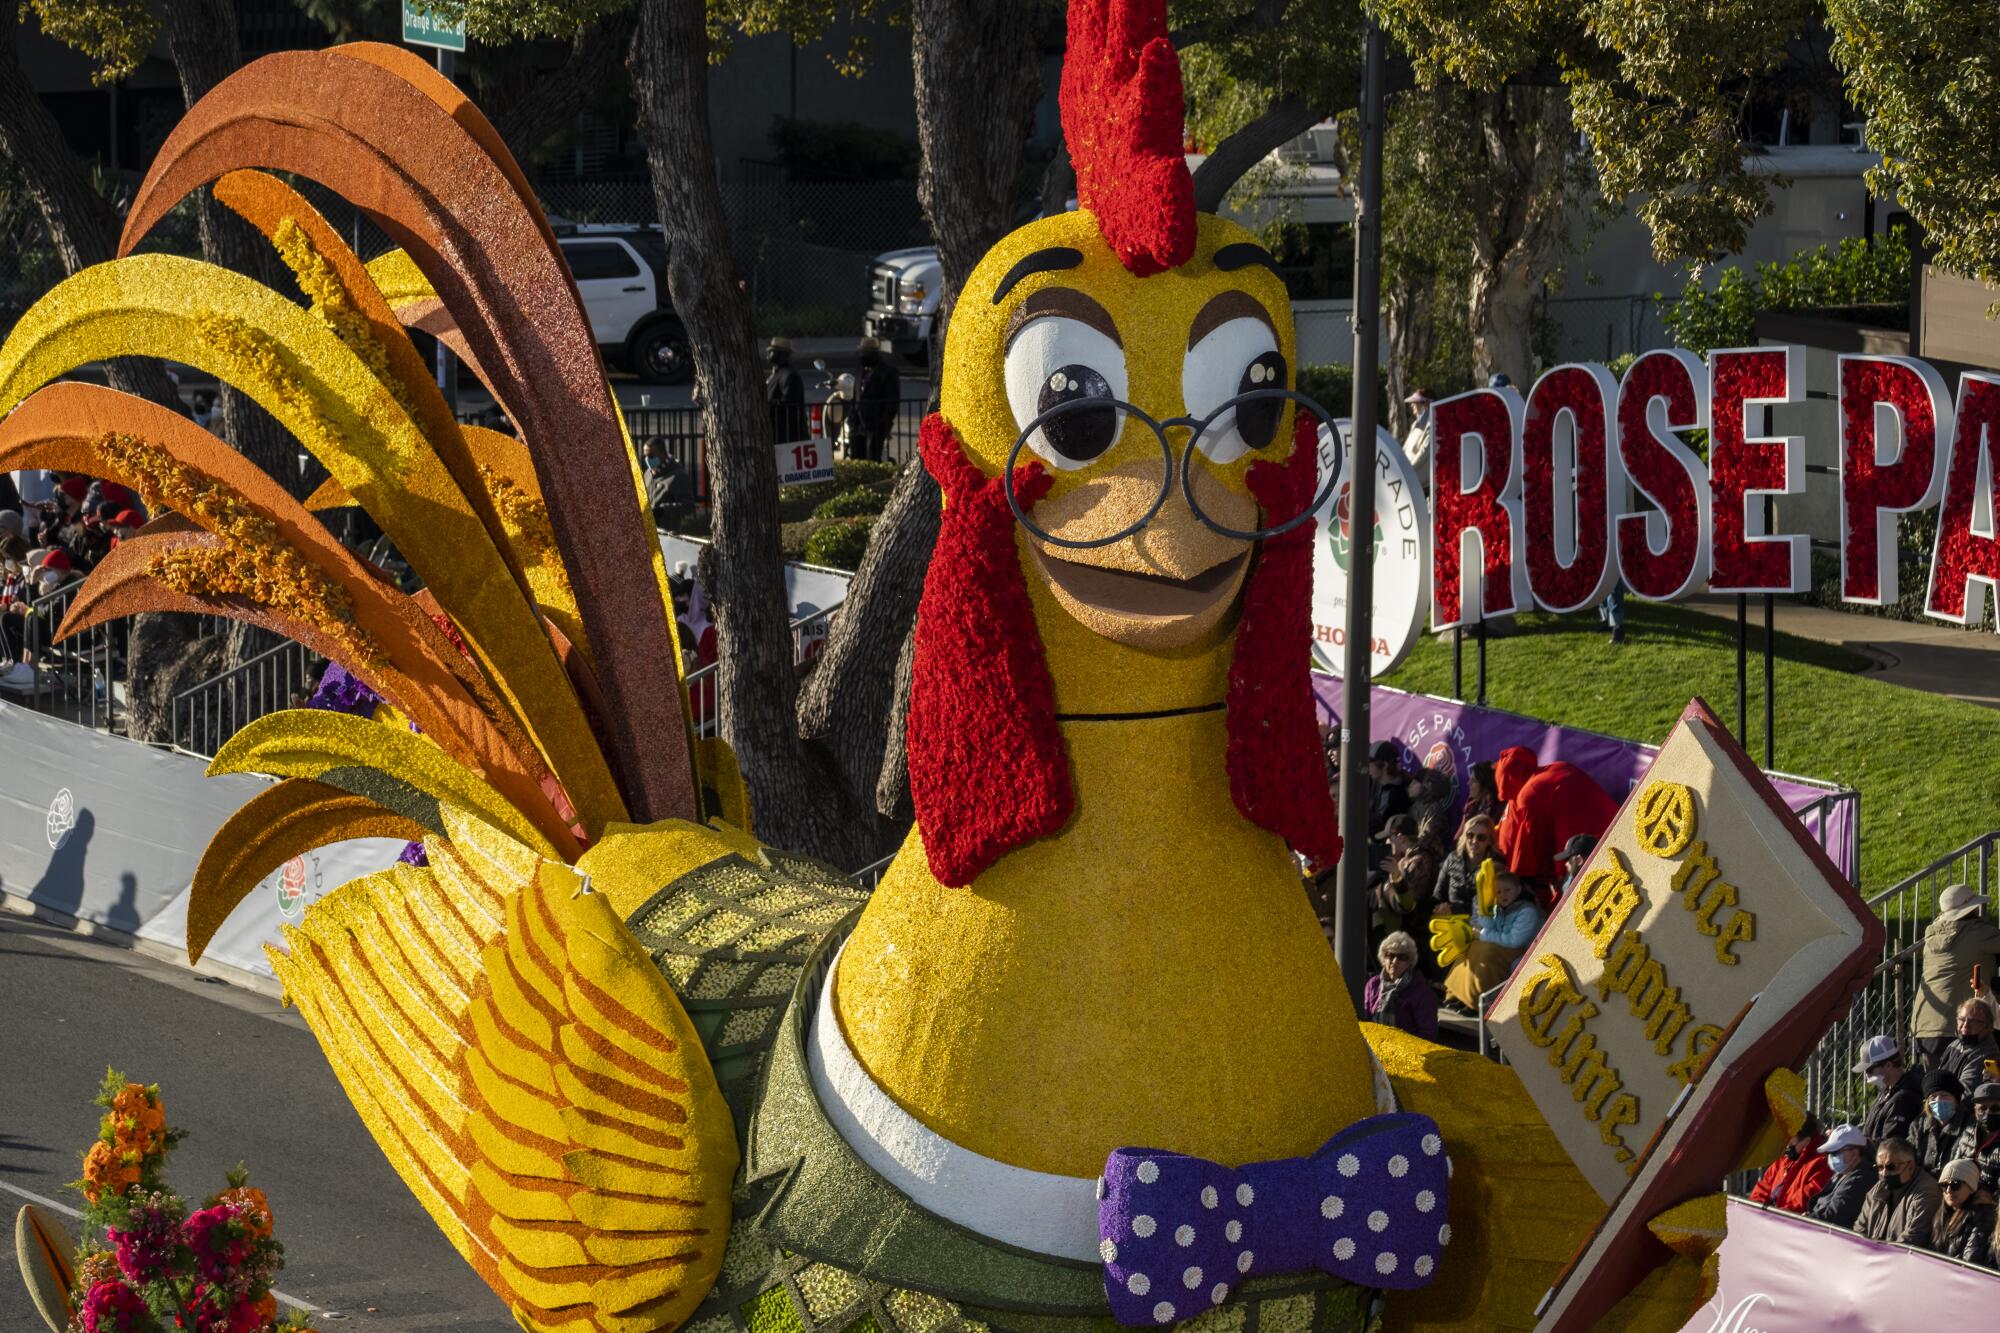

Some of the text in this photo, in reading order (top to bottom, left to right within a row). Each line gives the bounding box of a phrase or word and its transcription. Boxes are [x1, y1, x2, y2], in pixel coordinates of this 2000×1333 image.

[405, 9, 430, 35] Orange
[785, 471, 811, 483] ORANGE
[791, 443, 818, 471] 15
[1430, 345, 1811, 634] ROSE
[1403, 718, 1430, 772] OSE
[1634, 780, 1756, 967] Once
[1573, 847, 1695, 1058] Upon
